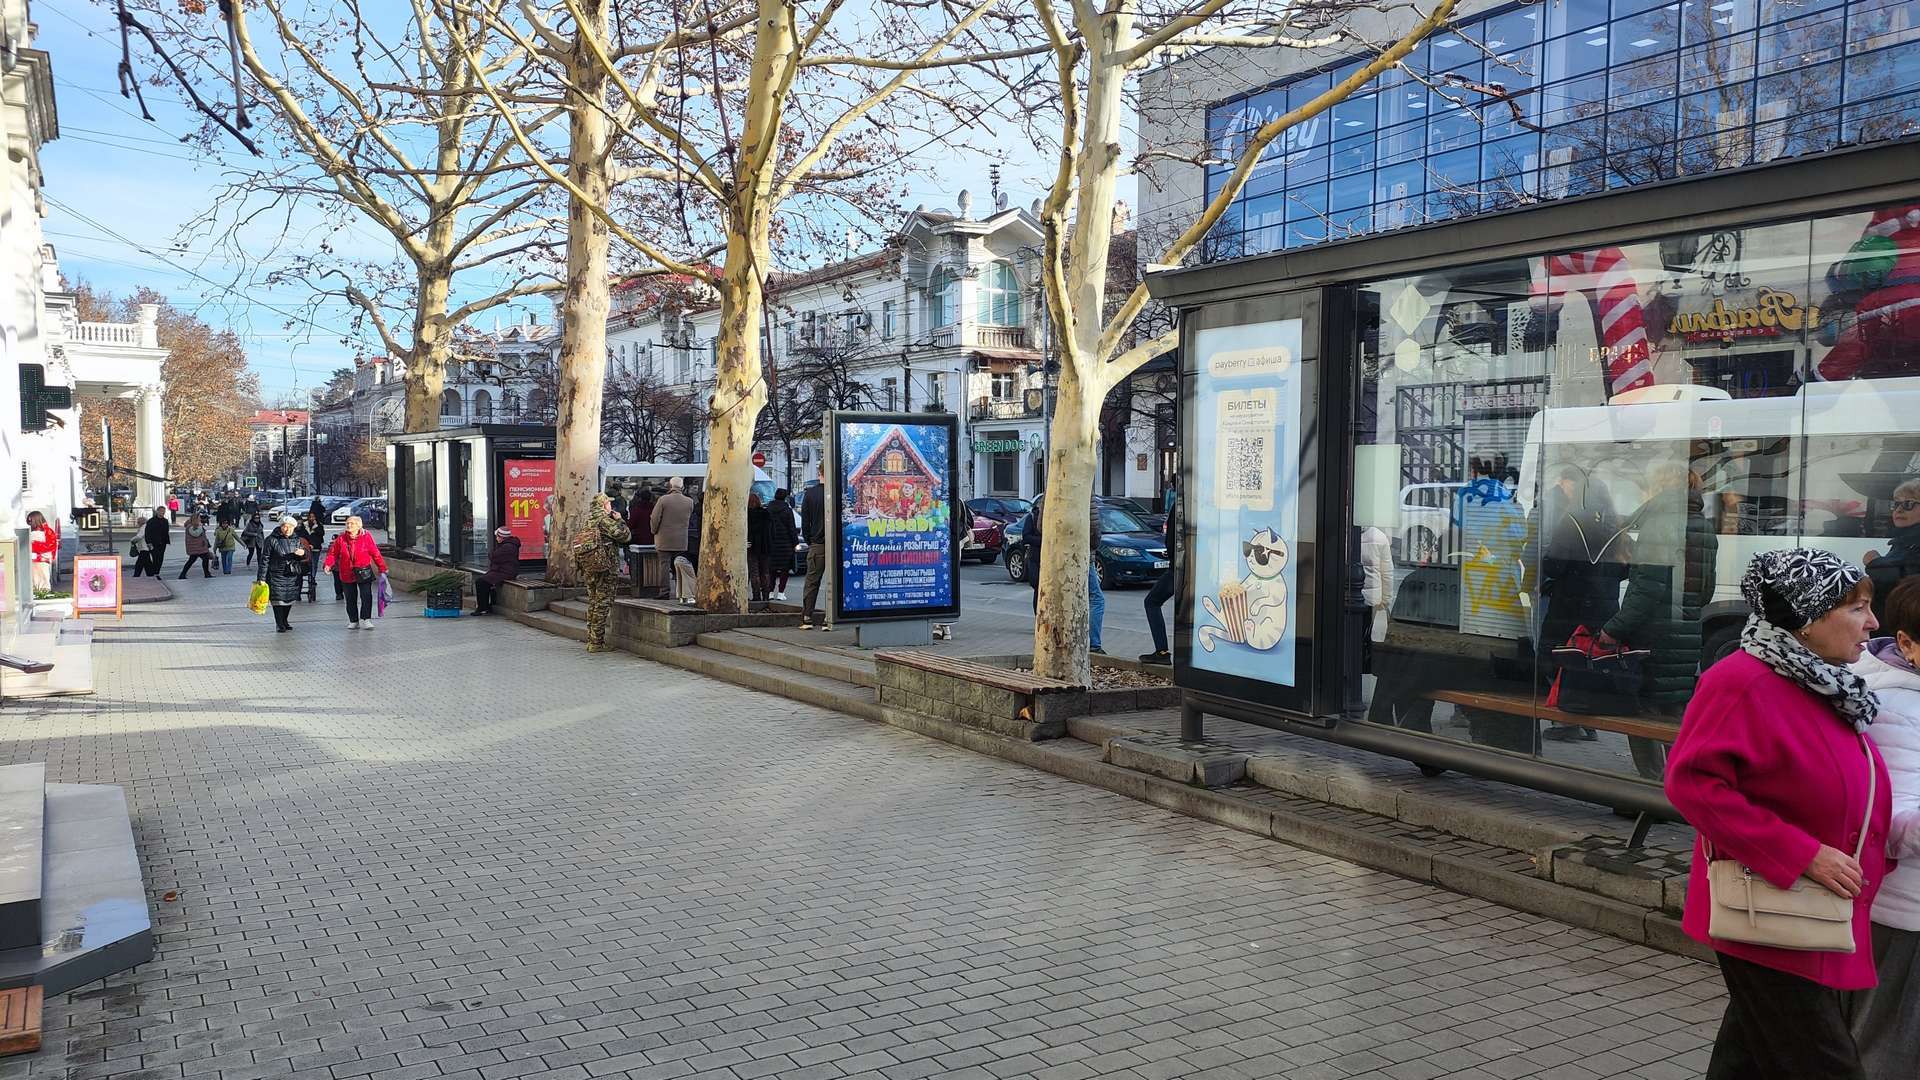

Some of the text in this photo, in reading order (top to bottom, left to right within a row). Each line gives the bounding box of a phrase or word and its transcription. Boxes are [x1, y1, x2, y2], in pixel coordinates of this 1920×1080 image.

[1215, 359, 1247, 371] payberry
[1227, 399, 1267, 411] БИЛЕТЫ
[510, 499, 540, 518] 11%
[852, 538, 940, 554] Новогодний РОЗЫГРЫШ
[904, 568, 936, 577] РОЗЫГРЫША
